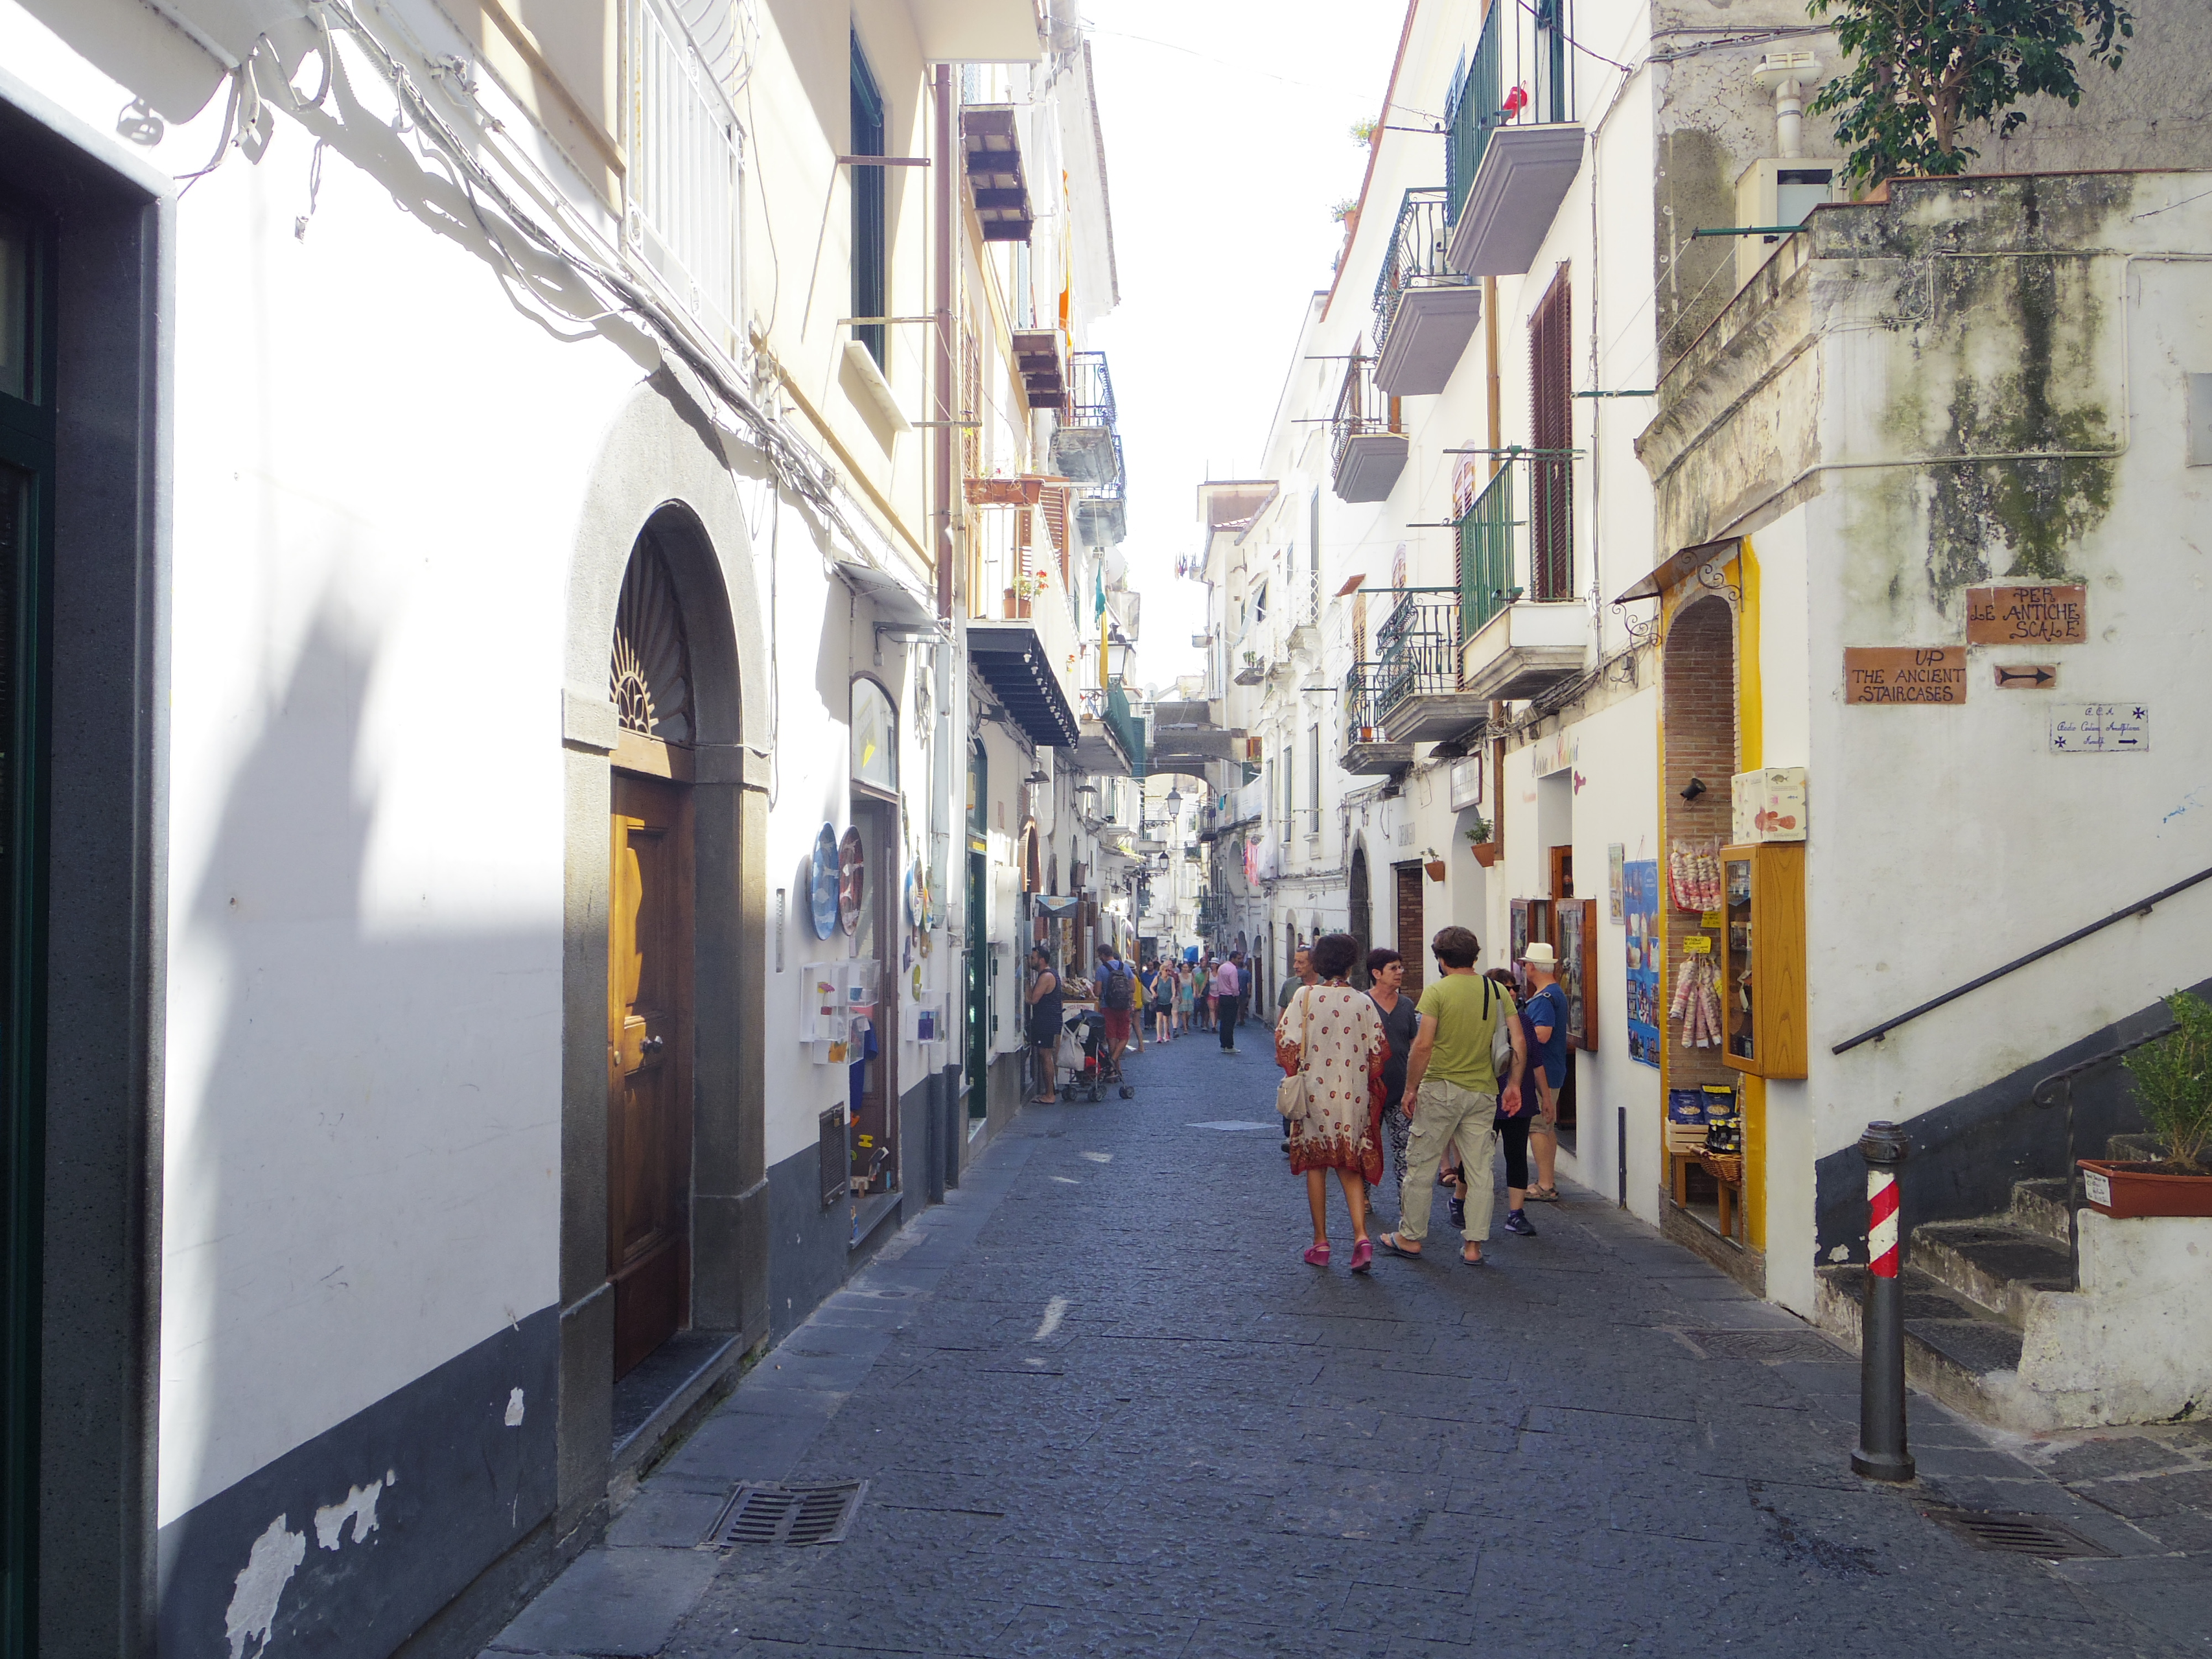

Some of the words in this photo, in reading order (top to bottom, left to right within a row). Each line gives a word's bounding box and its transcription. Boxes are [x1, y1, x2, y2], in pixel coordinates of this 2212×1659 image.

[2013, 588, 2055, 602] PER
[1970, 605, 1996, 621] LE
[2003, 603, 2080, 620] ANTICHE
[2010, 620, 2080, 642] SCALE
[1916, 650, 1944, 666] UP
[1852, 669, 1885, 684] THE
[1895, 668, 1966, 683] ANCIENT
[1858, 686, 1953, 702] STAIRCASES
